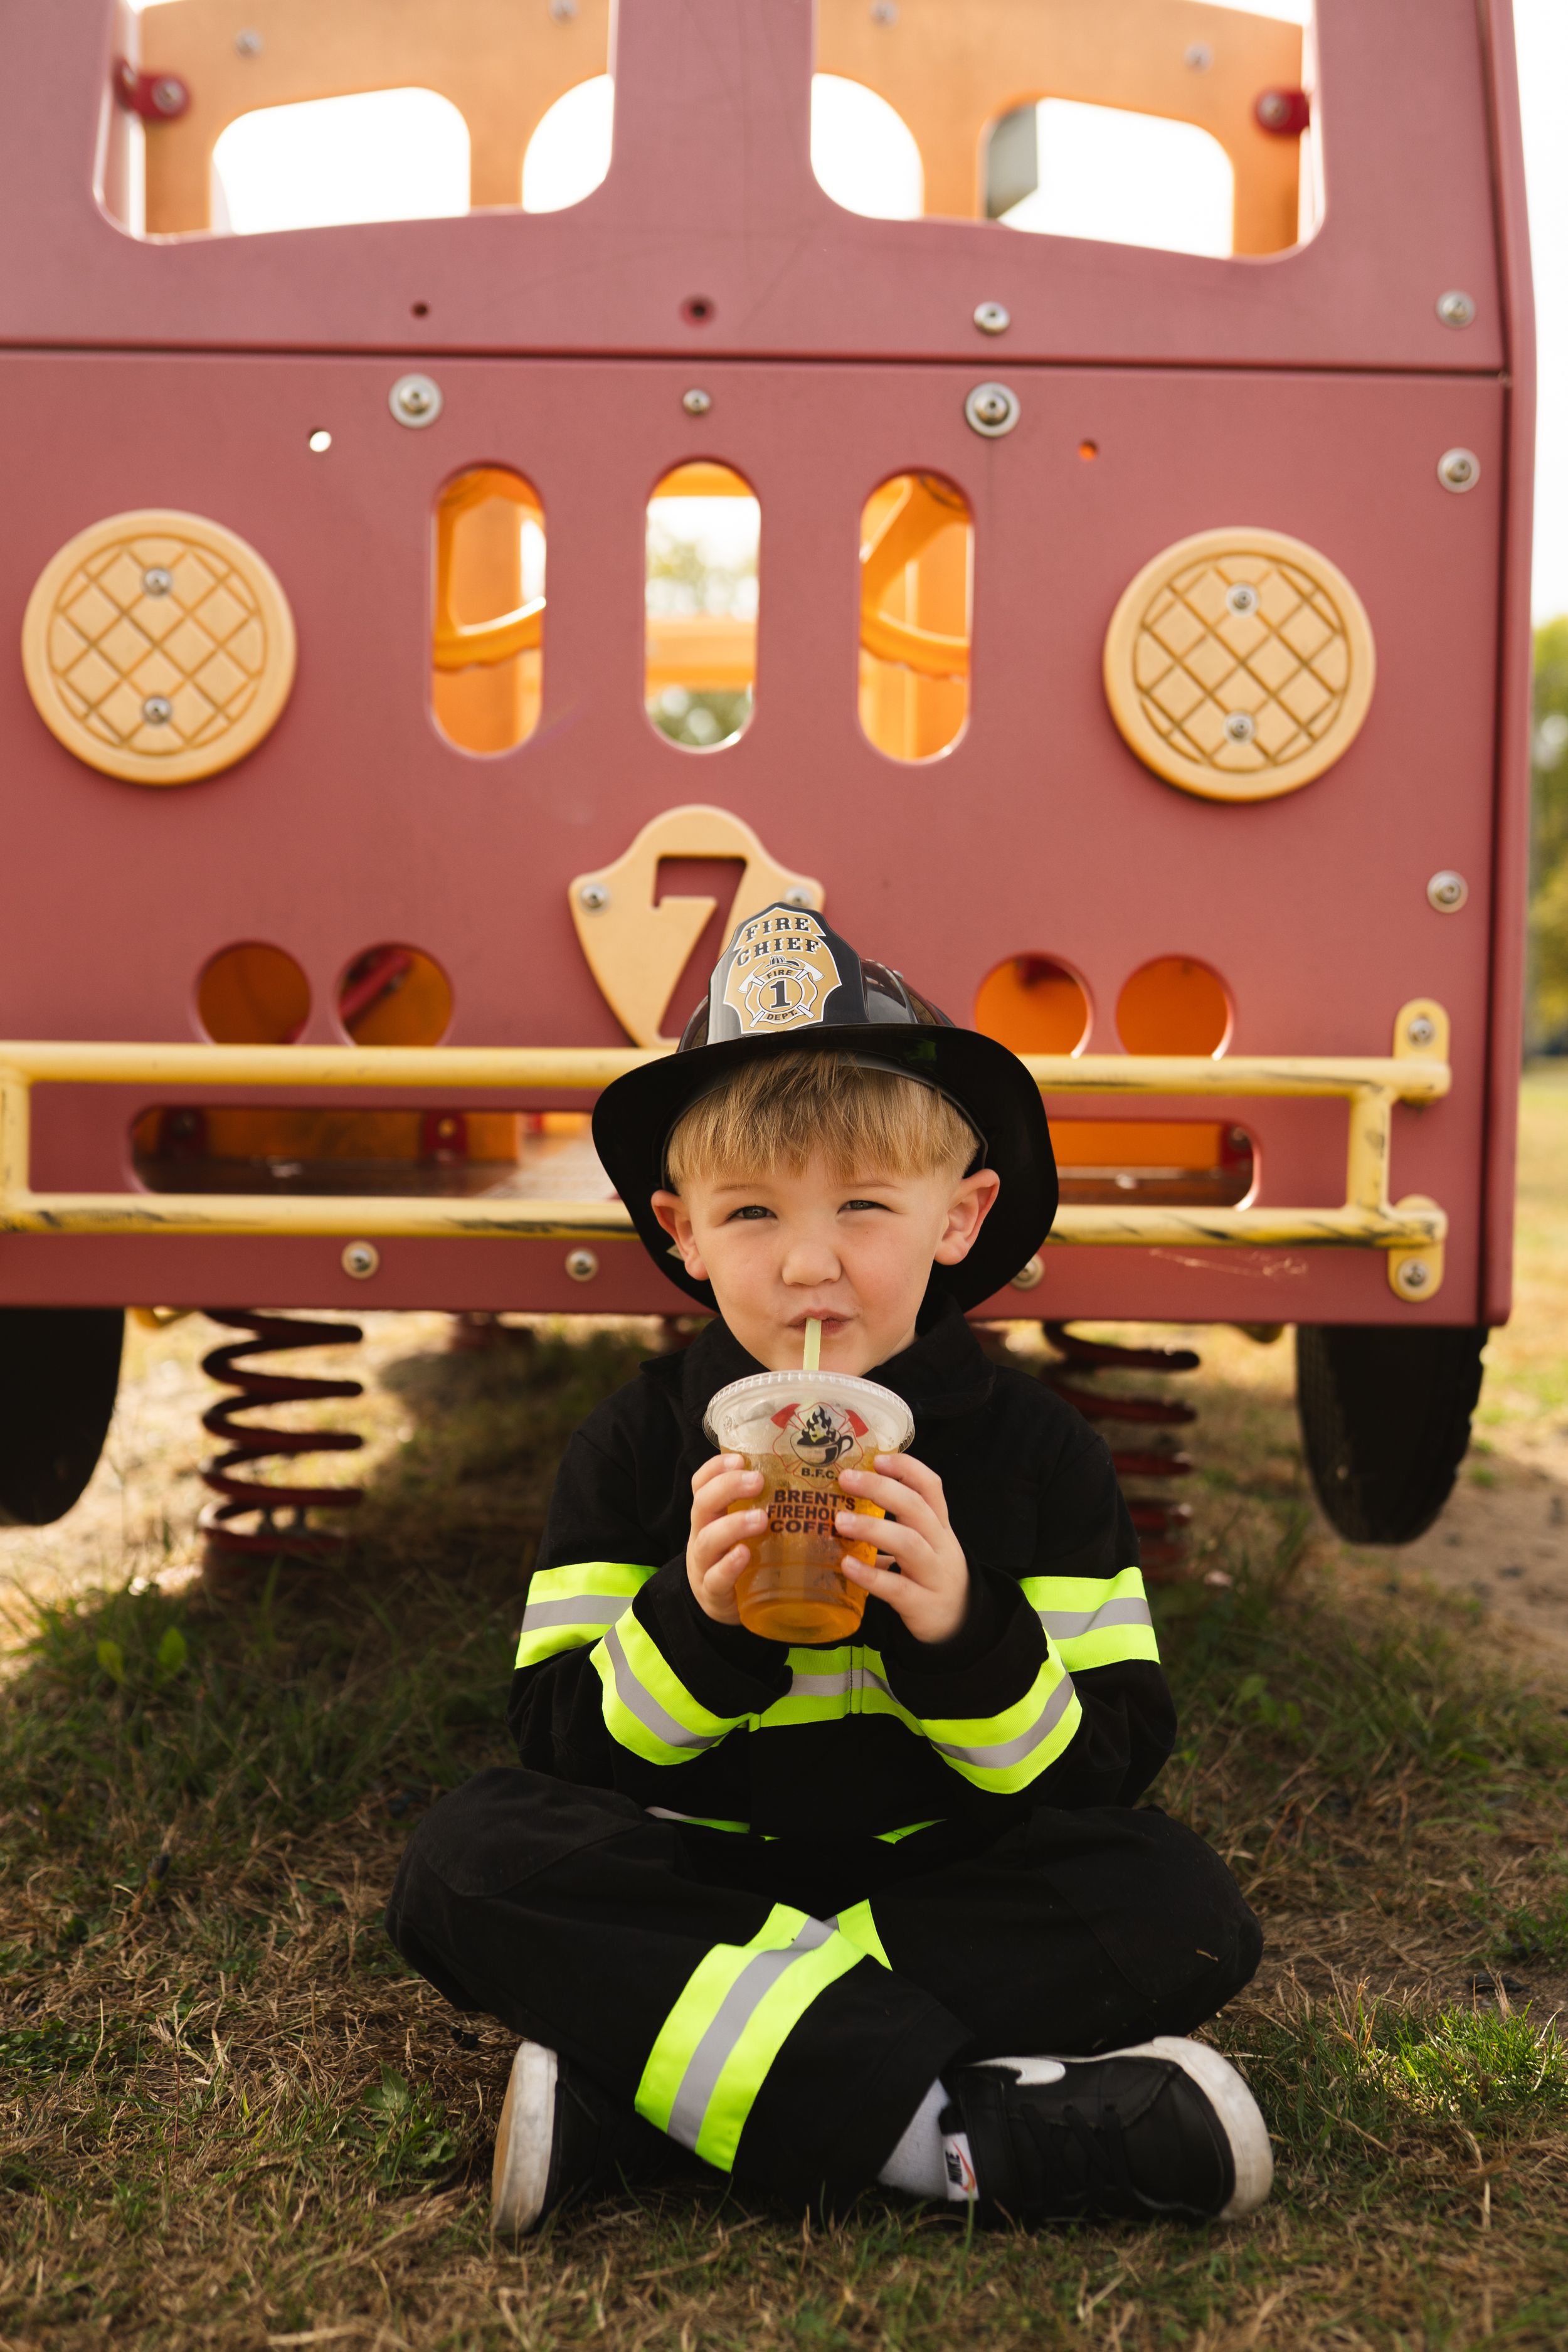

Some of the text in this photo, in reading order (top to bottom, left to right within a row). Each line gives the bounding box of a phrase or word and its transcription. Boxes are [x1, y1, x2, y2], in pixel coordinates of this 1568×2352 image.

[745, 918, 810, 943] FIRE
[653, 856, 748, 1038] 7
[737, 937, 820, 967] CHIEF
[766, 970, 793, 978] FIRE
[770, 980, 791, 1008] 1
[766, 1009, 798, 1020] DEPT.
[802, 1468, 838, 1480] B.F.C.
[775, 1490, 856, 1510] BRENT'S
